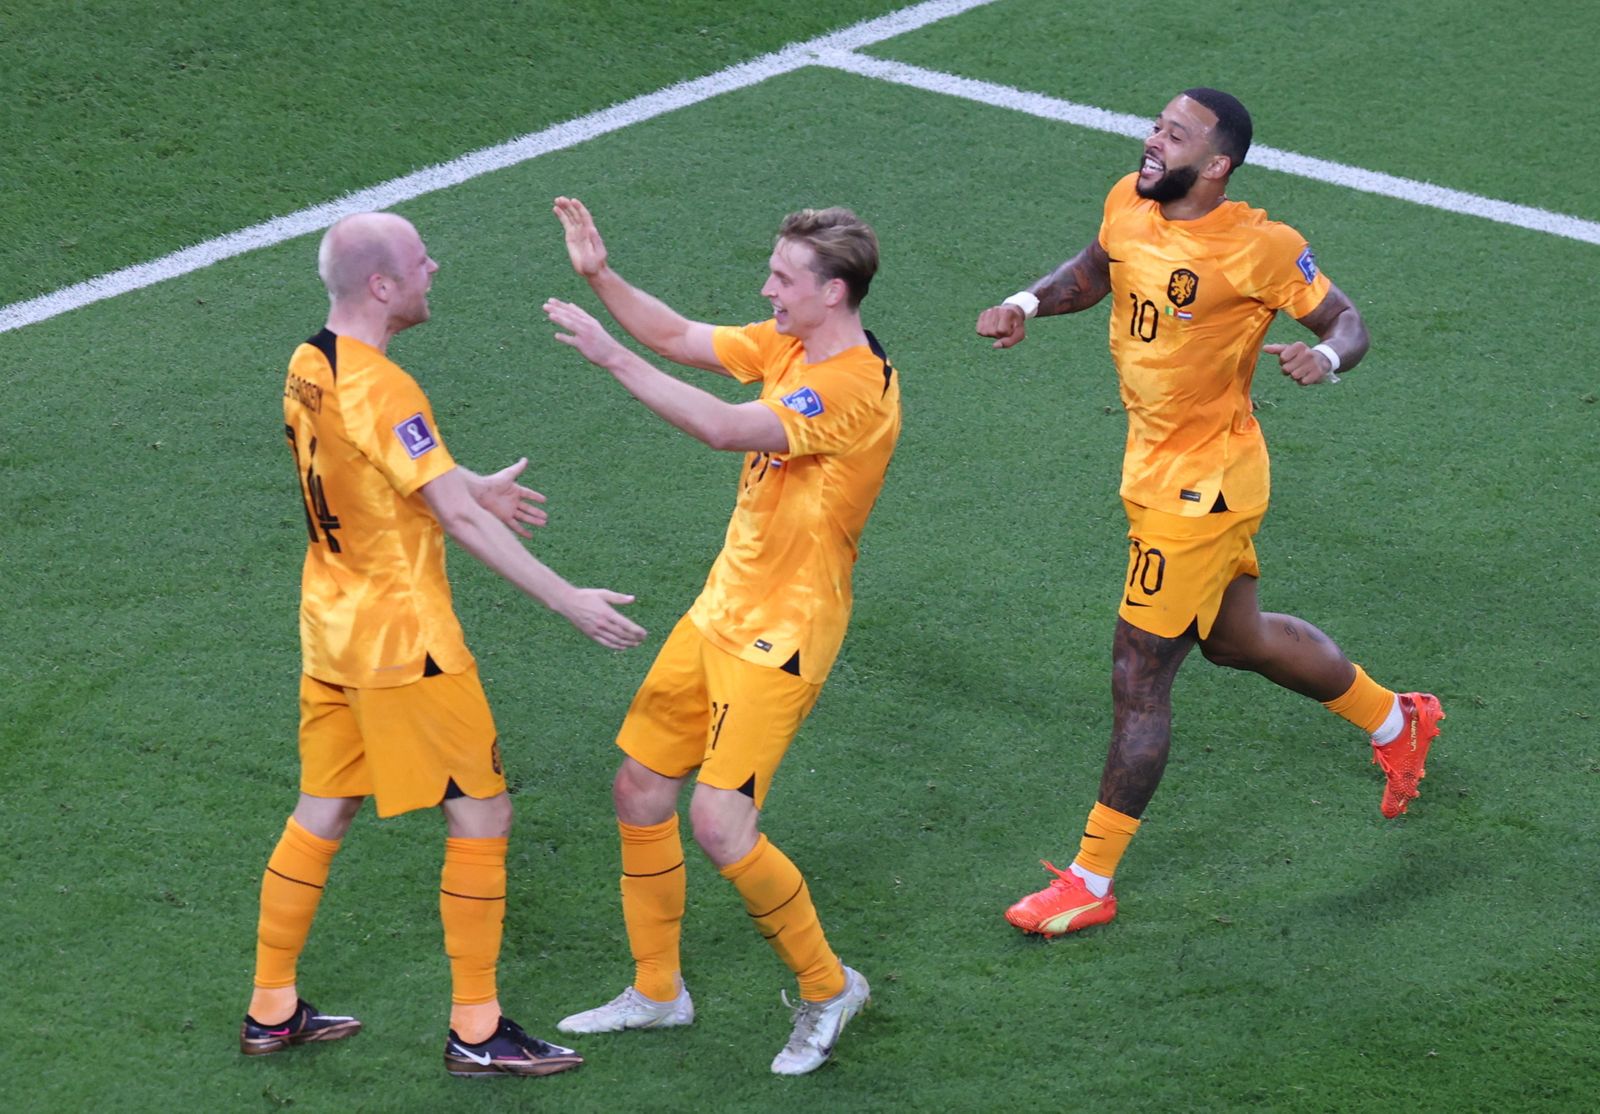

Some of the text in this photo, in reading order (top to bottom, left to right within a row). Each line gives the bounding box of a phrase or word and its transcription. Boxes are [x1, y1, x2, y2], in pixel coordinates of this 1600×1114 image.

[1130, 292, 1158, 343] 10
[285, 425, 340, 552] 14
[1130, 541, 1165, 596] 10
